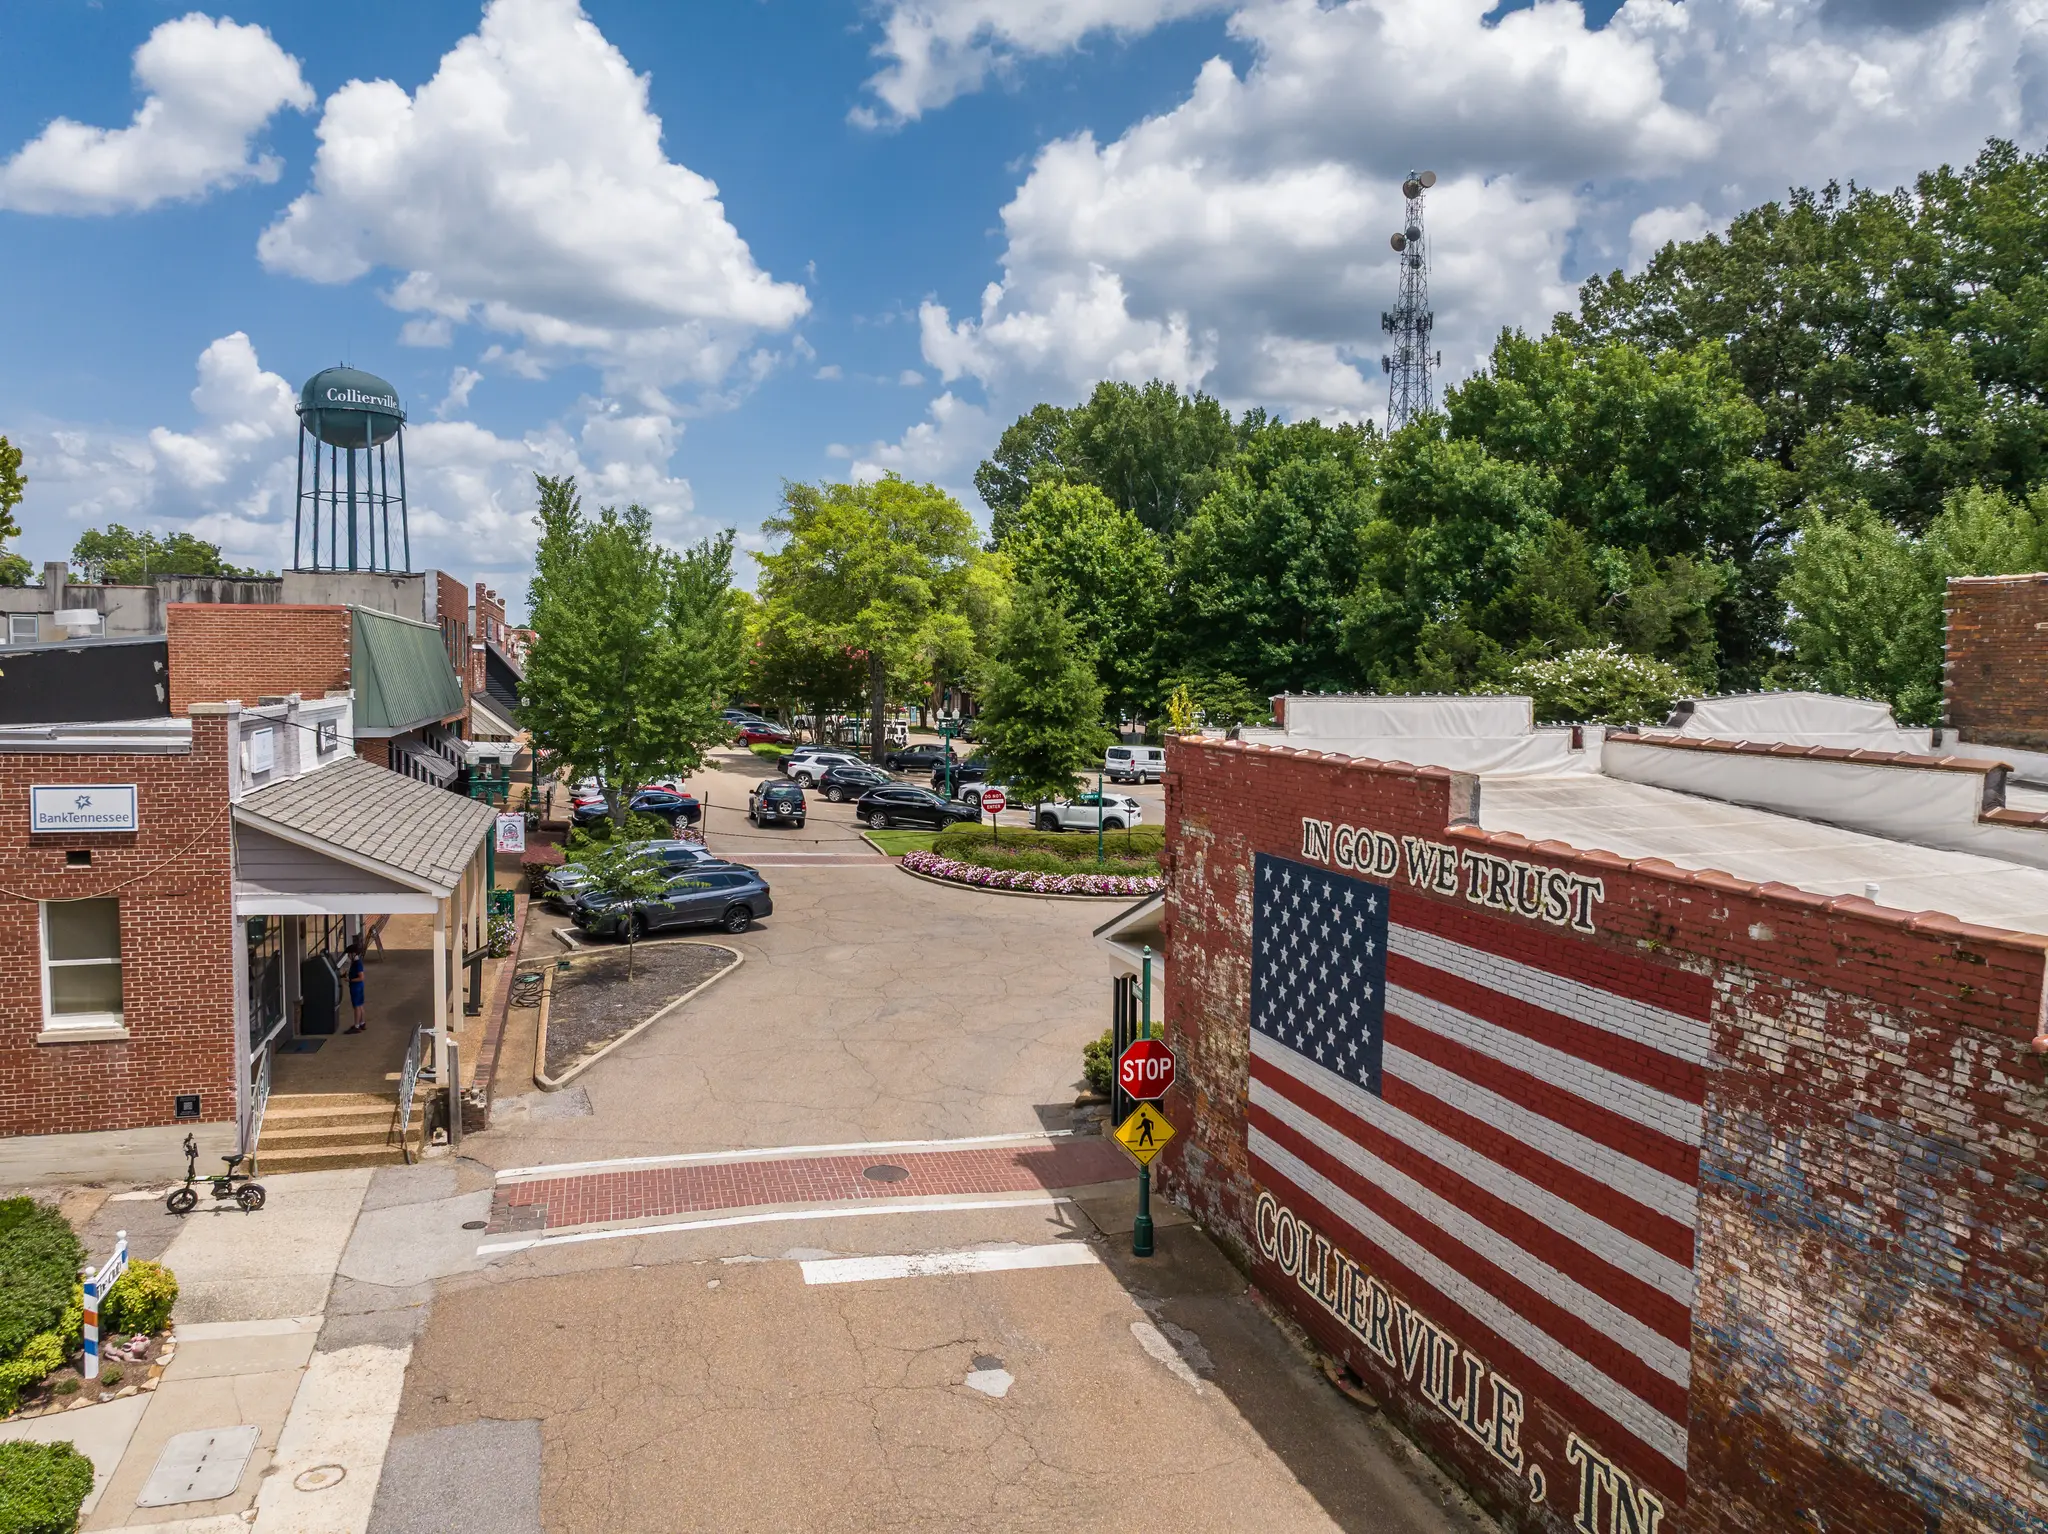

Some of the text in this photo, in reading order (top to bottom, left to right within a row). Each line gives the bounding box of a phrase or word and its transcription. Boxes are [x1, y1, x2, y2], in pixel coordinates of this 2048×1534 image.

[327, 387, 397, 409] Collierville
[39, 812, 129, 823] BankTennessee
[1302, 817, 1605, 935] IN GOD WE TRUST
[1122, 1057, 1172, 1082] STOP
[1564, 1432, 1664, 1534] TN
